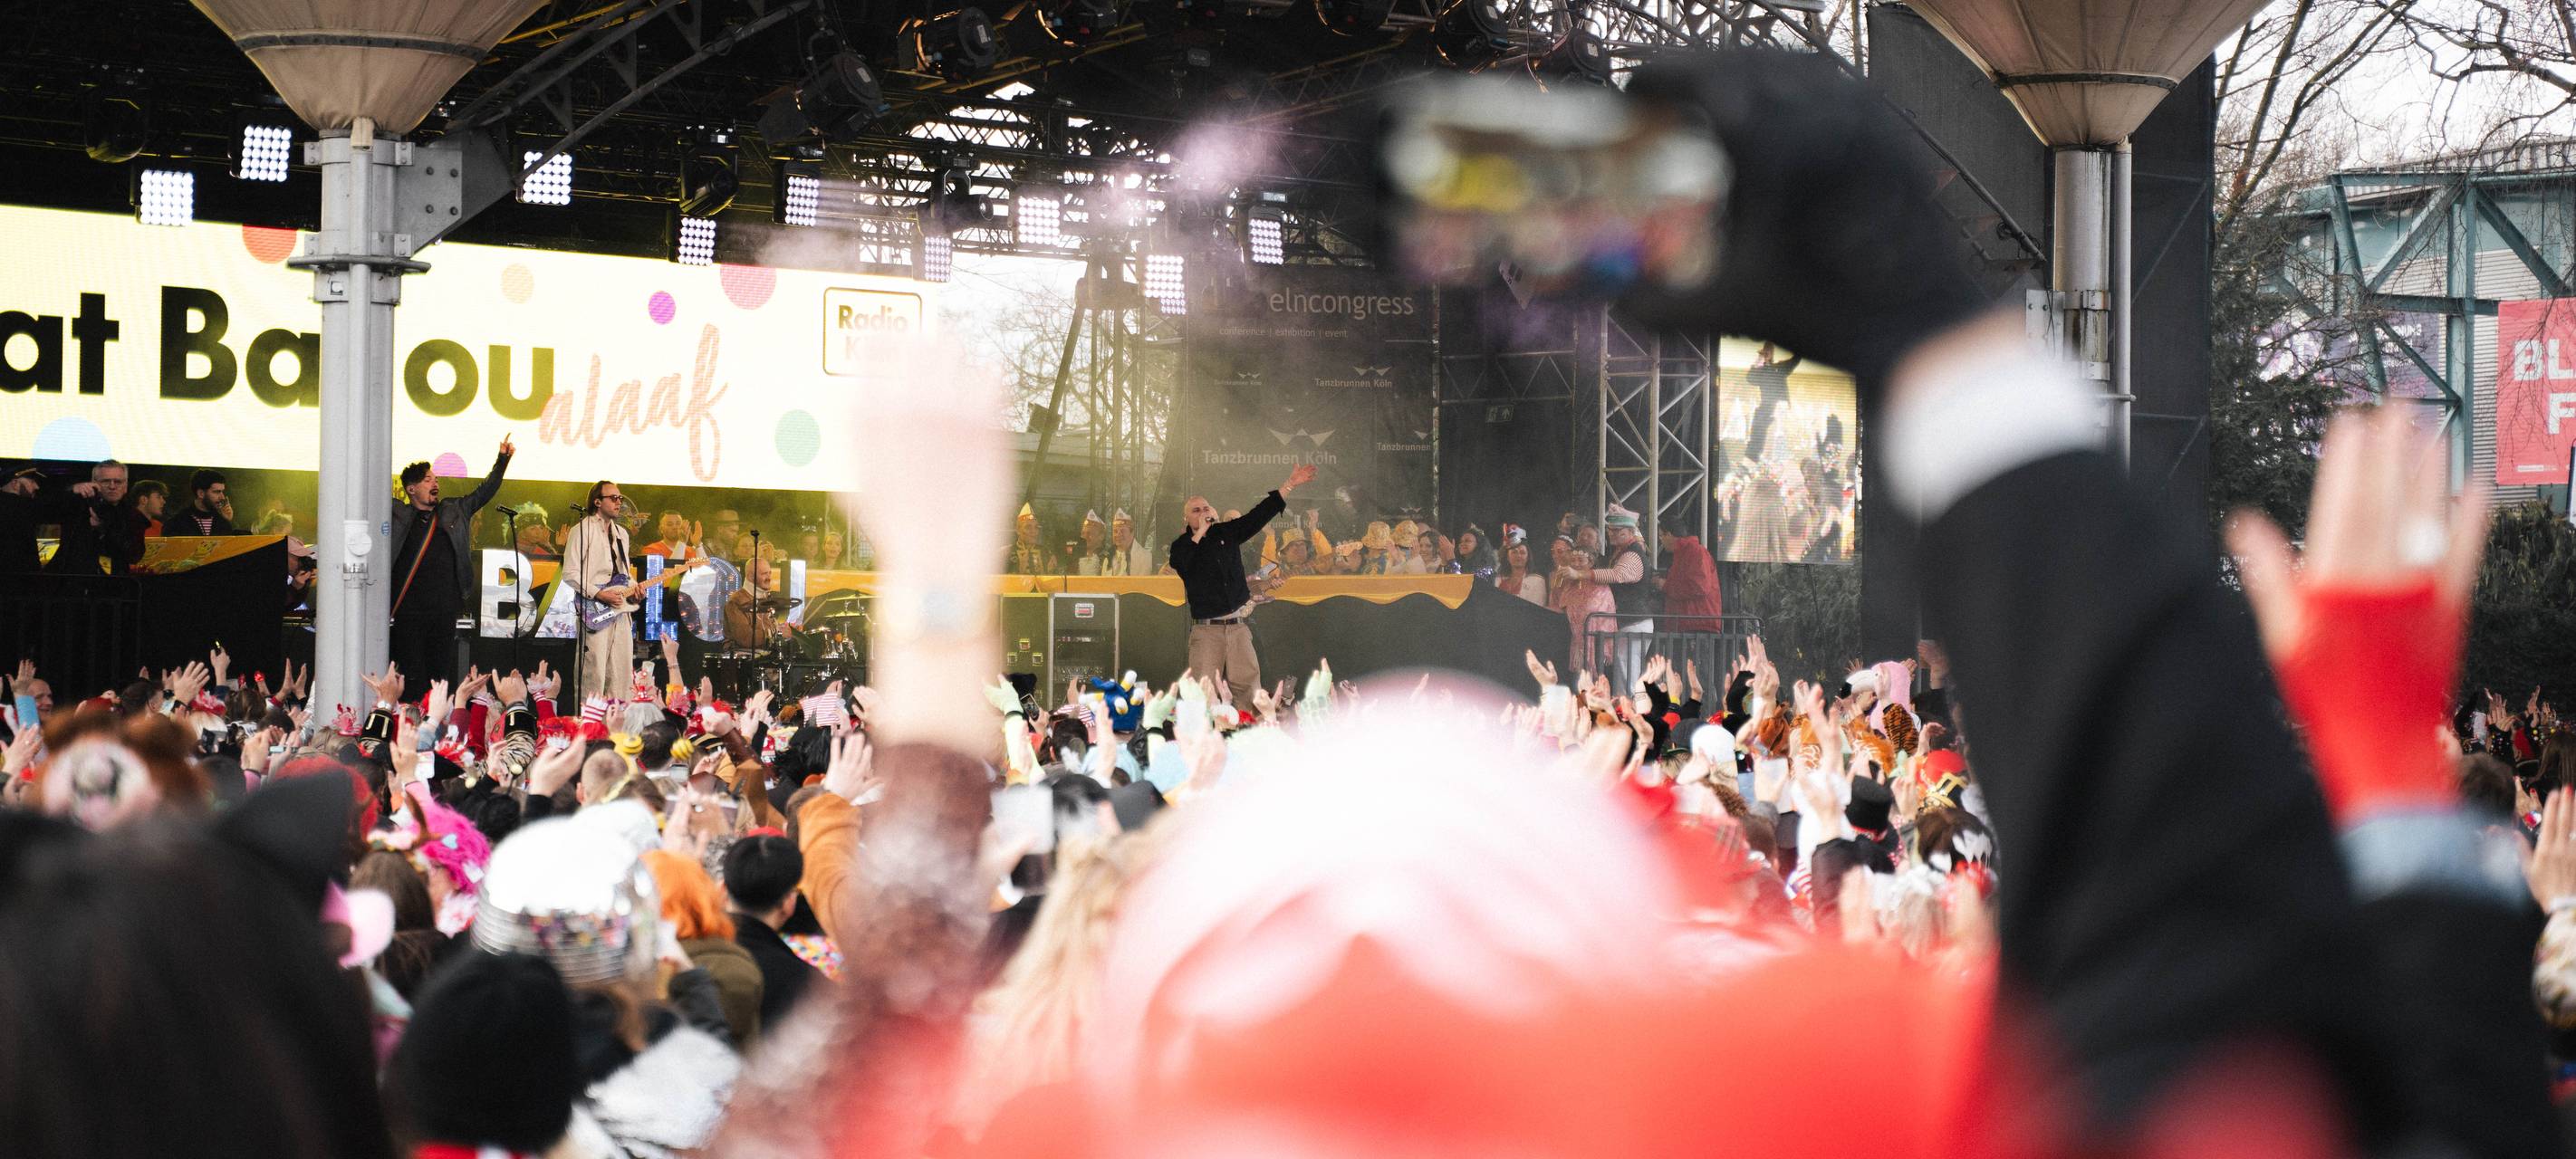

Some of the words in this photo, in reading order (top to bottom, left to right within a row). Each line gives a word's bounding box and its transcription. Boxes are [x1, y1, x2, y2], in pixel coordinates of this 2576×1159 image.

[838, 305, 908, 332] Radio
[1274, 328, 1316, 338] exhibition
[1325, 329, 1348, 338] event
[159, 285, 554, 421] Baou
[1314, 378, 1370, 388] Tanzbrunnen
[1373, 378, 1392, 388] Köln
[539, 323, 728, 483] alaaf
[1376, 442, 1431, 452] Tanzbrunnen
[1202, 449, 1299, 465] Tanzbrunnen
[1305, 449, 1338, 465] Köln
